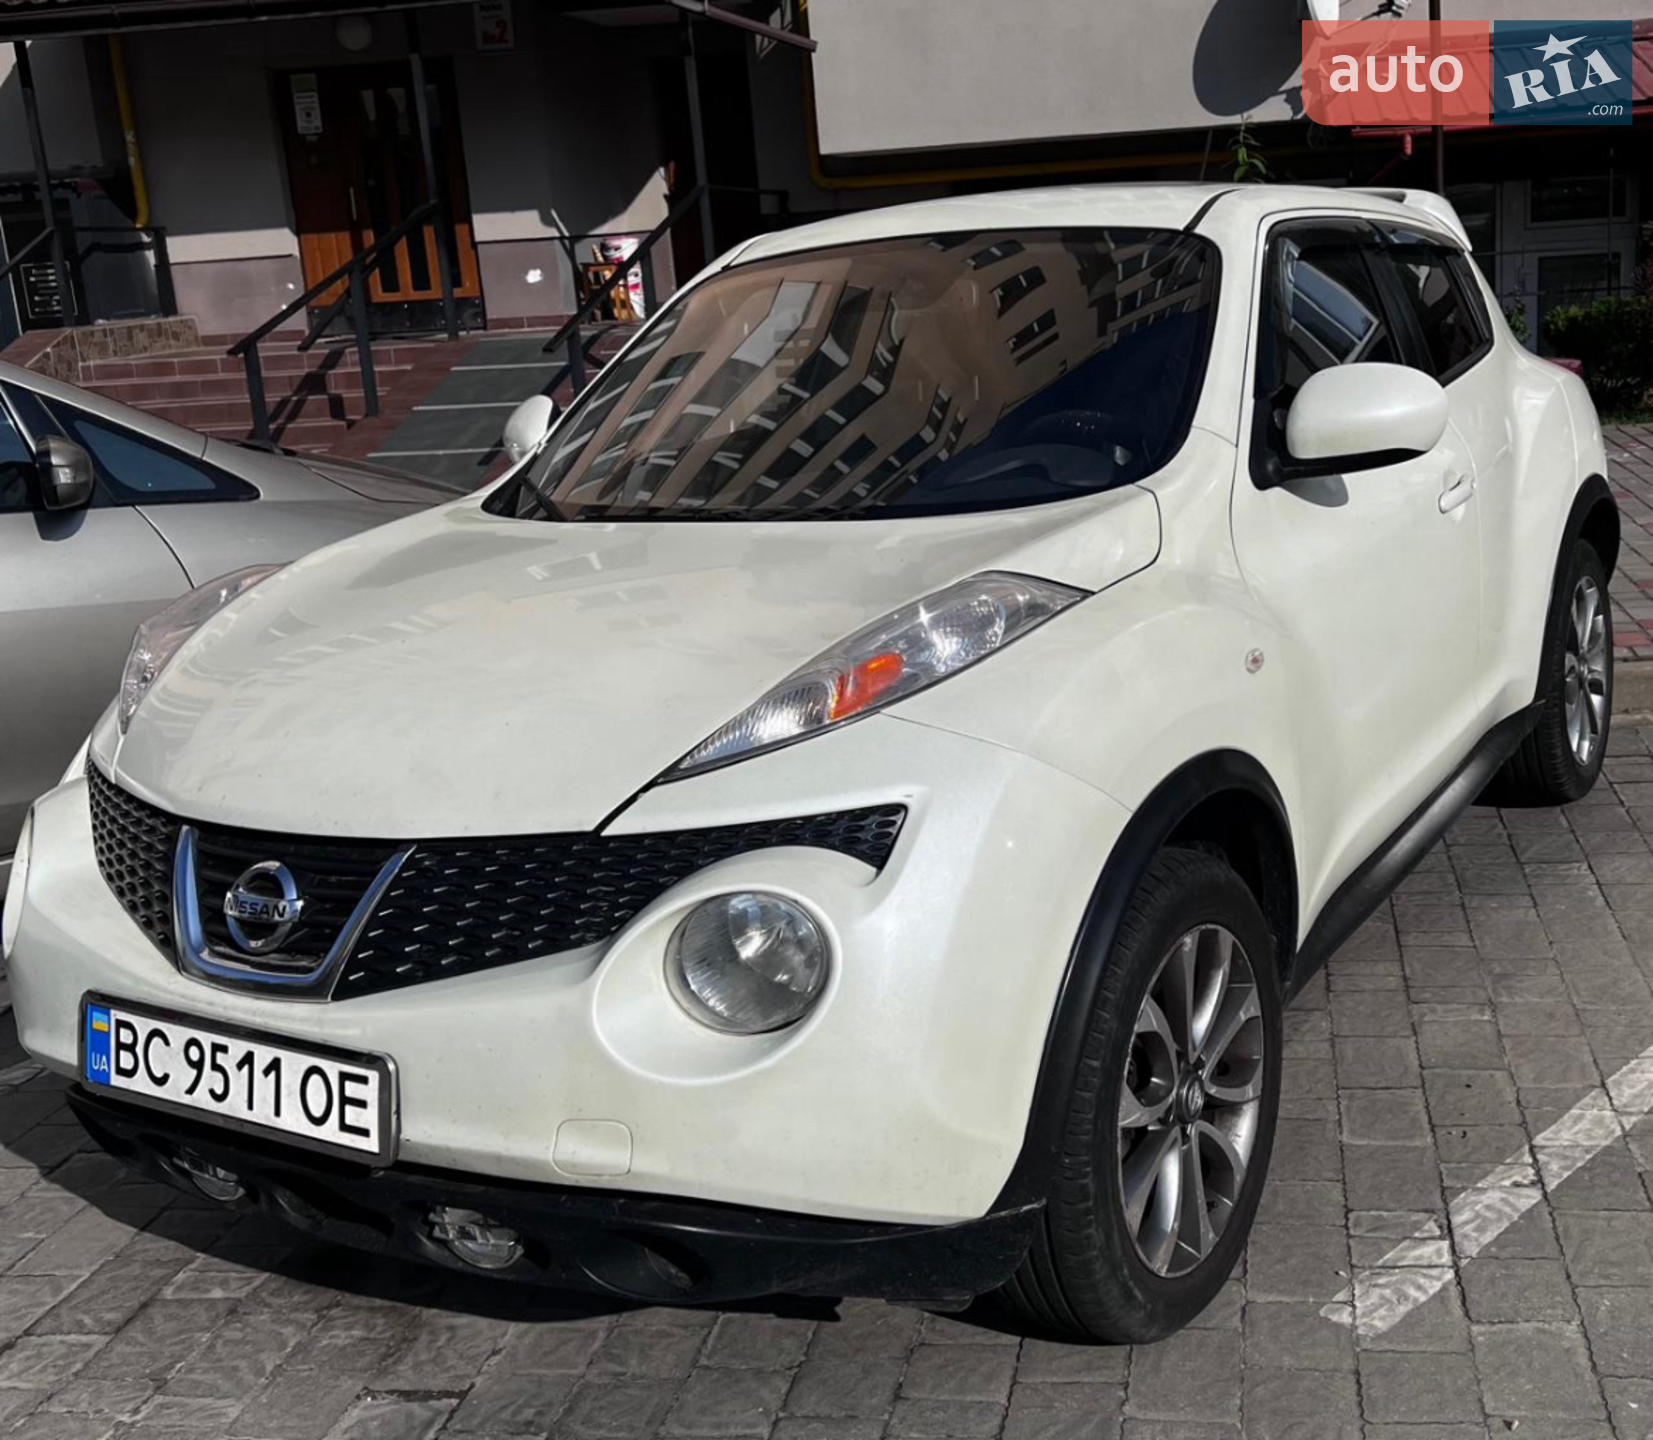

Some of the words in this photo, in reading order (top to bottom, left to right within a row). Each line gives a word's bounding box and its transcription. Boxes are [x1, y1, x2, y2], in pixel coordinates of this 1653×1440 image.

[225, 893, 287, 918] NISSAN
[92, 1051, 109, 1073] UA
[115, 1018, 170, 1087] BC
[184, 1037, 281, 1118] 9511
[300, 1065, 370, 1138] OE
